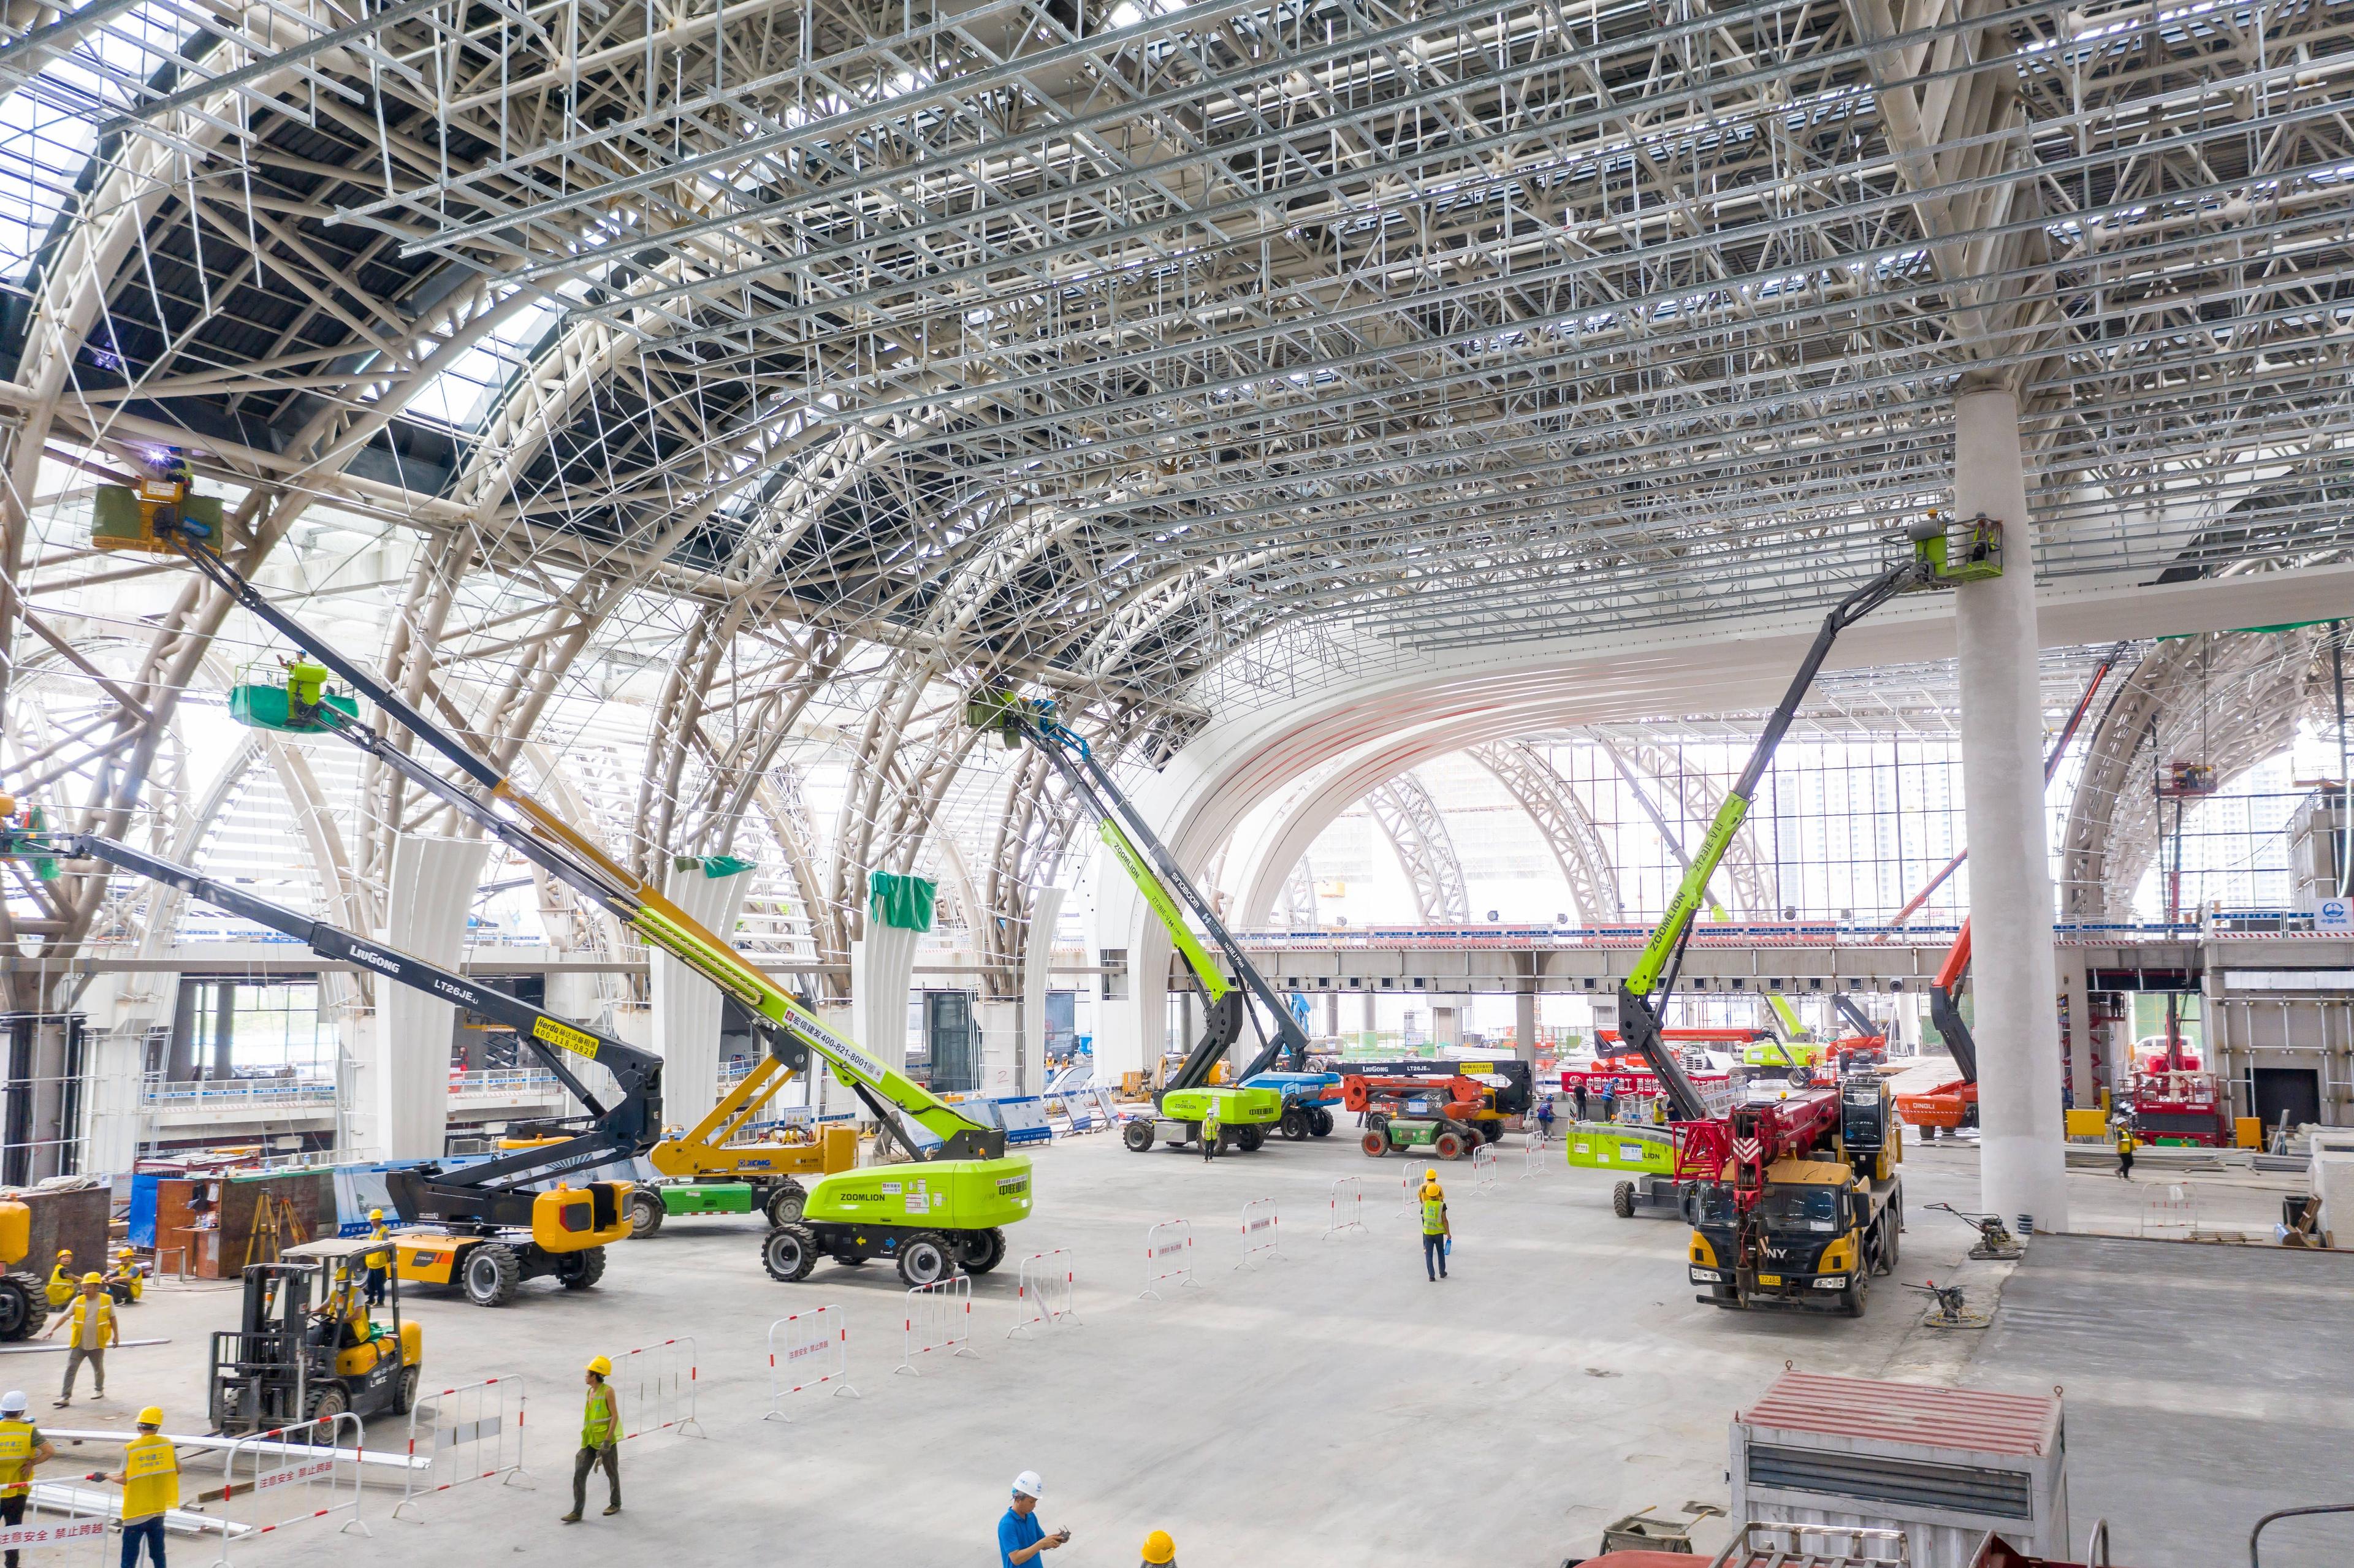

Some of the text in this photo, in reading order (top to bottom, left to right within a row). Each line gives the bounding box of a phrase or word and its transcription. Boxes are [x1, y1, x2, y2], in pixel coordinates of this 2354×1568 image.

[1114, 842, 1140, 879] ZOOMLION
[1171, 872, 1200, 908] SINOBOOM
[1650, 891, 1686, 952] ZOOMLION
[1235, 956, 1244, 969] Plus
[535, 1027, 595, 1057] 400-118-0828
[793, 1016, 868, 1069] 宏信建发 400-821-8001
[999, 1181, 1027, 1195] 中联重科
[1767, 1248, 1787, 1258] NY
[260, 1461, 333, 1489] 注意安全 禁止跨越
[0, 1523, 104, 1545] 注意安全 禁止跨越
